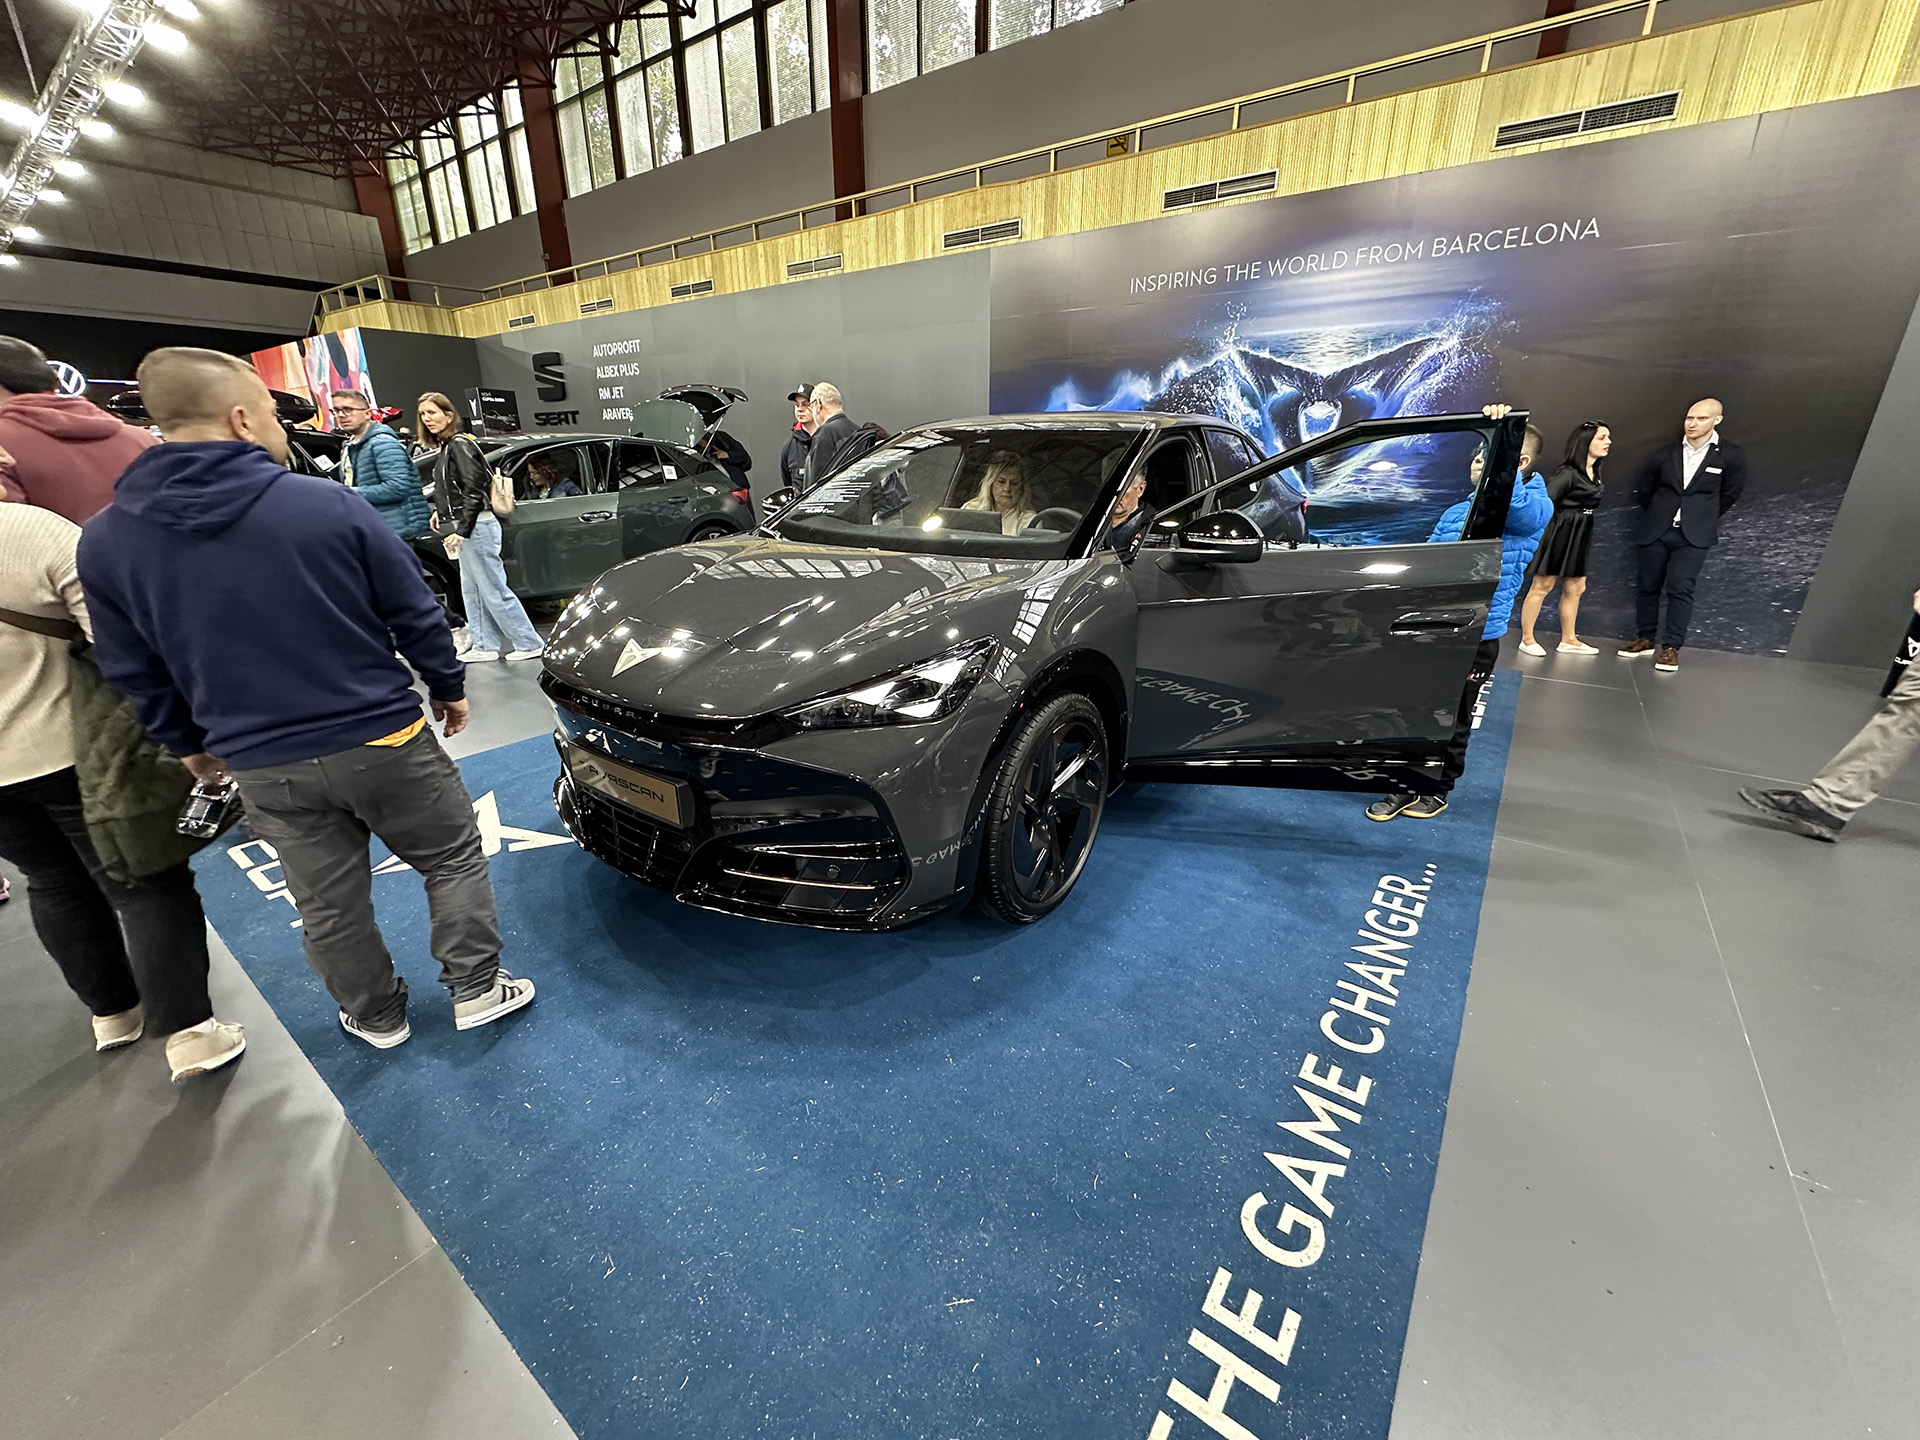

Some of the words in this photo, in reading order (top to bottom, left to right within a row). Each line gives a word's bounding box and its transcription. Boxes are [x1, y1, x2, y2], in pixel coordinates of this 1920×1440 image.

[1129, 267, 1217, 294] INSPIRING
[1223, 261, 1262, 283] THE
[1267, 250, 1348, 277] WORLD
[1355, 240, 1425, 267] FROM
[1431, 216, 1601, 258] BARCELONA
[593, 339, 641, 358] AUTOPROFIT
[596, 364, 620, 379] ALBEX
[620, 362, 640, 377] PLUS
[598, 387, 611, 400] RM
[612, 386, 624, 399] JET
[534, 410, 580, 427] SEAT
[1147, 1265, 1302, 1440] HE
[1240, 1052, 1374, 1269] GAME
